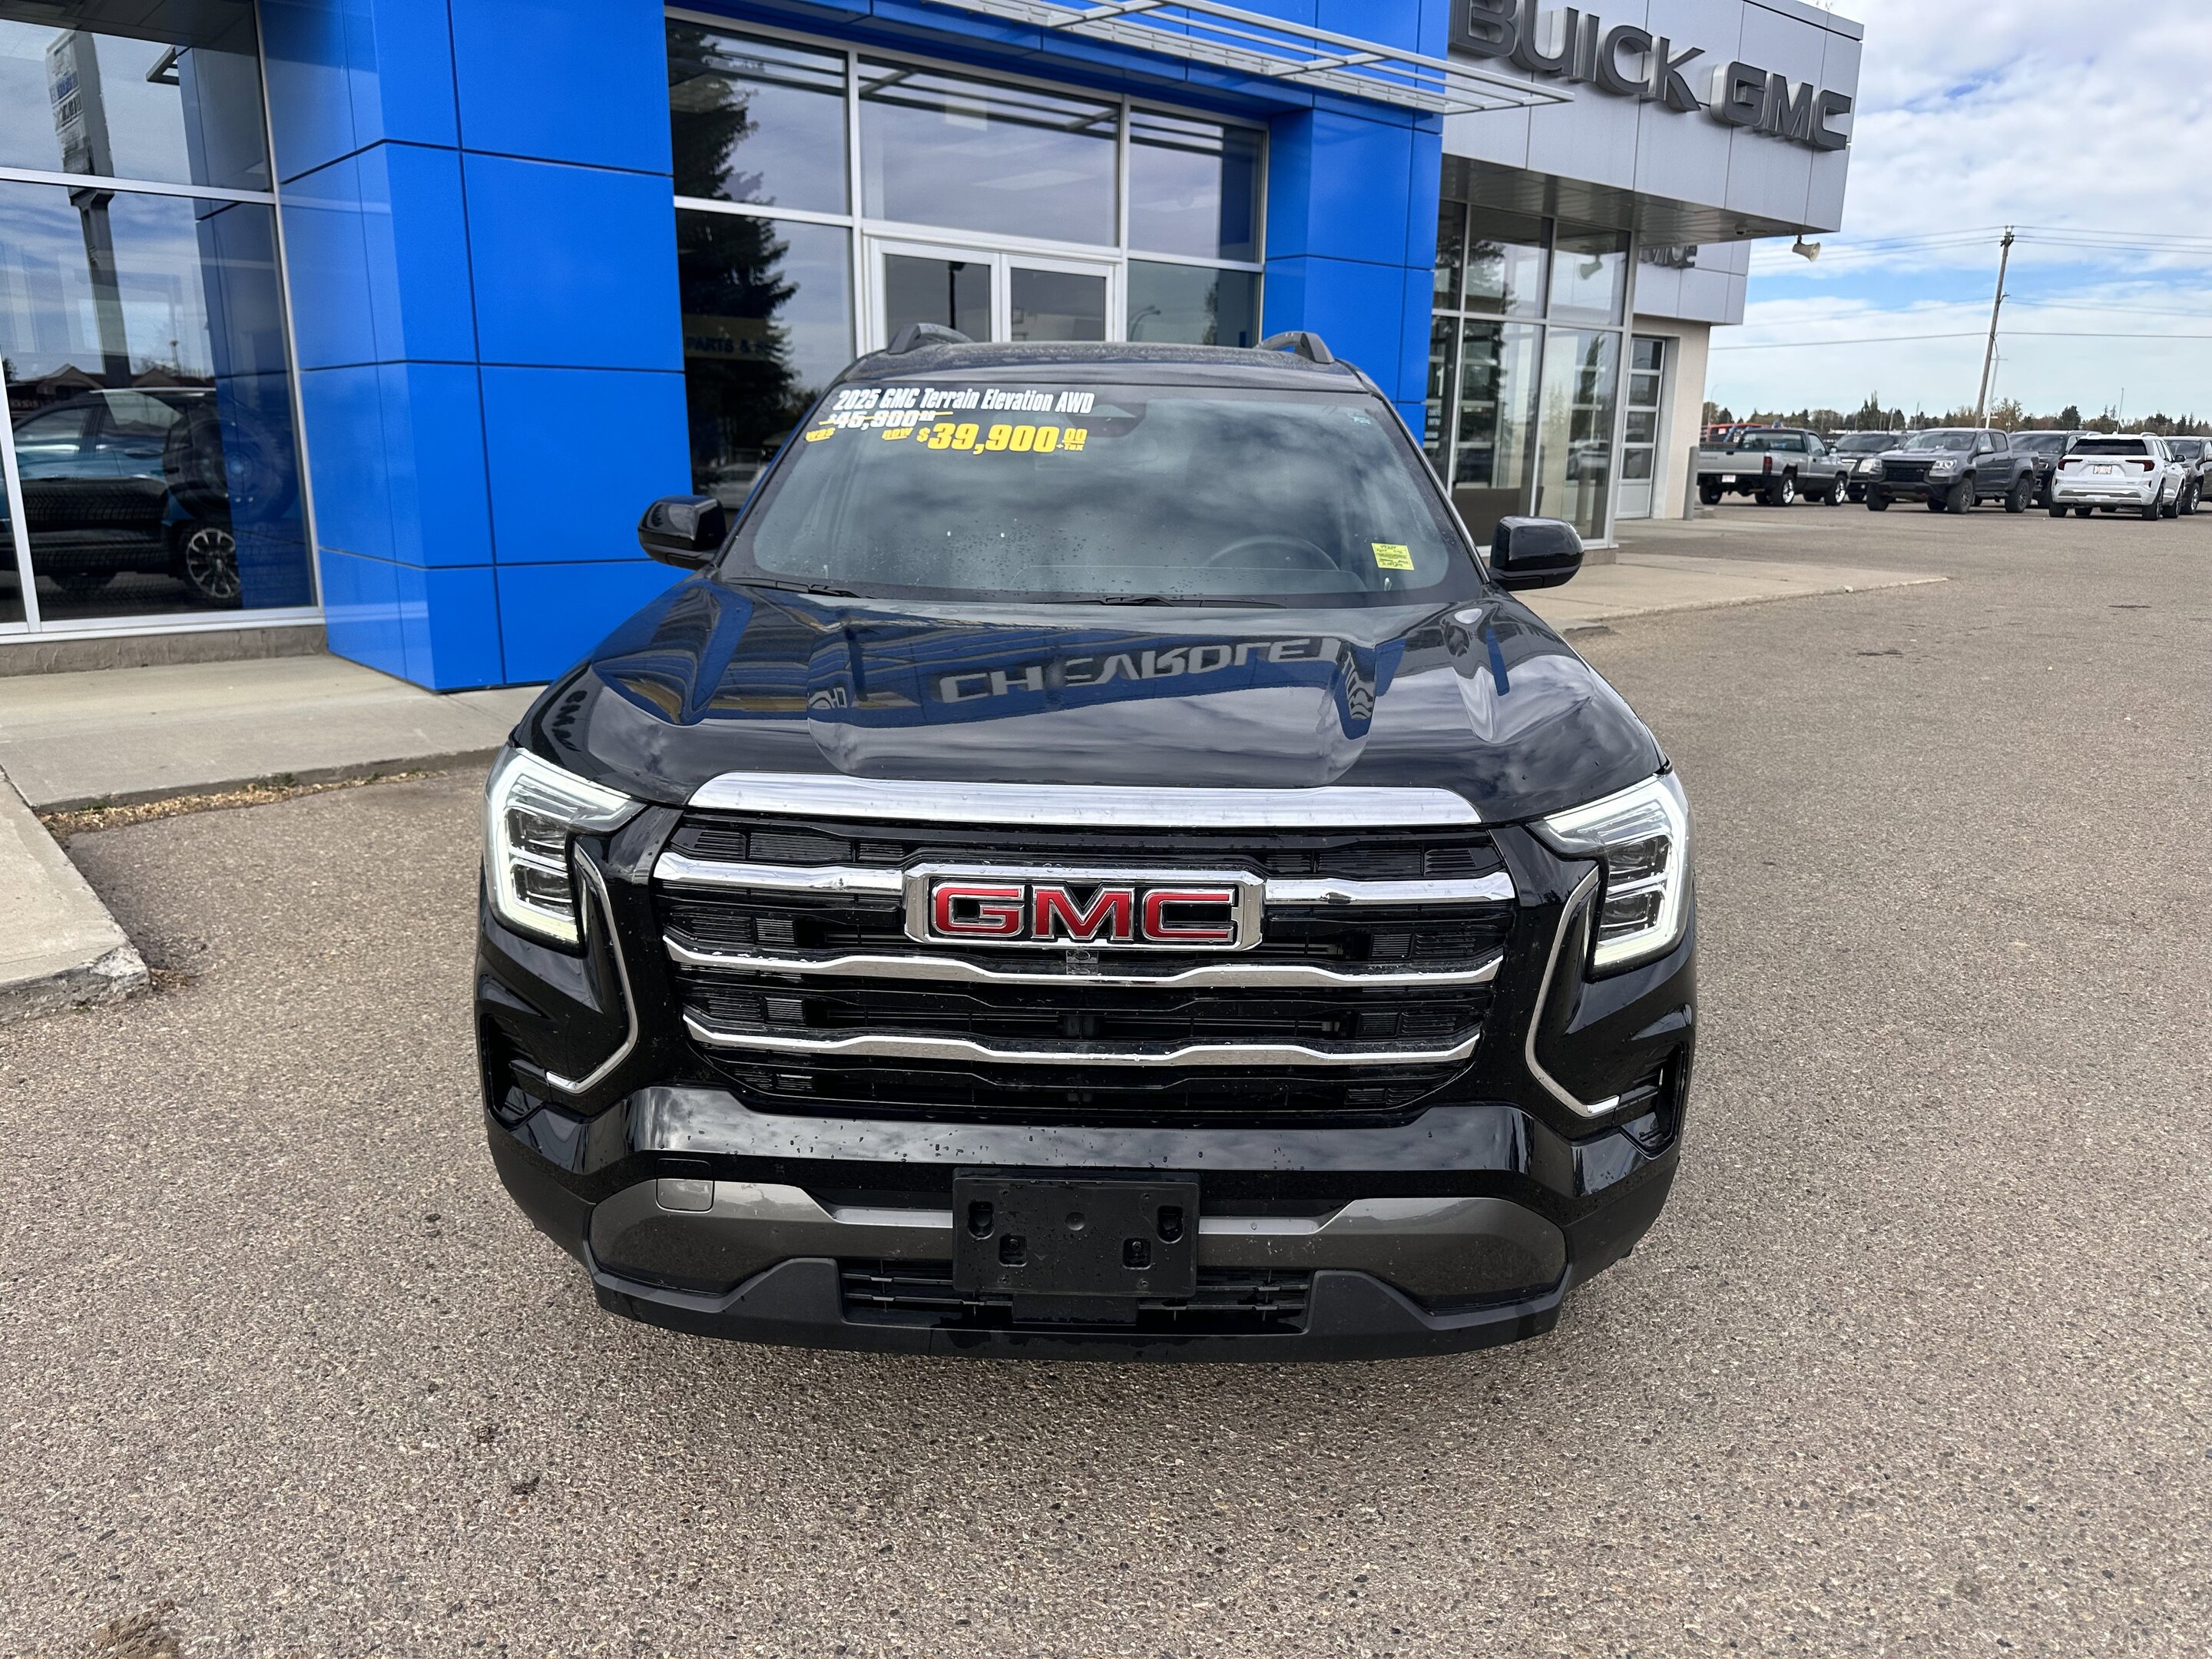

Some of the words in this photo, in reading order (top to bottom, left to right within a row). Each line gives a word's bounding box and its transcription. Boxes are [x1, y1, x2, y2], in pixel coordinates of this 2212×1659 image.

[1452, 0, 1705, 112] BUICK
[1711, 61, 1852, 151] GMC
[1638, 244, 1697, 269] VICE
[832, 388, 882, 410] 2025
[879, 388, 921, 409] GMC
[919, 387, 980, 409] Terrain
[980, 388, 1054, 412] Elevation
[1055, 391, 1095, 414] AWD
[931, 880, 1235, 943] GMC
